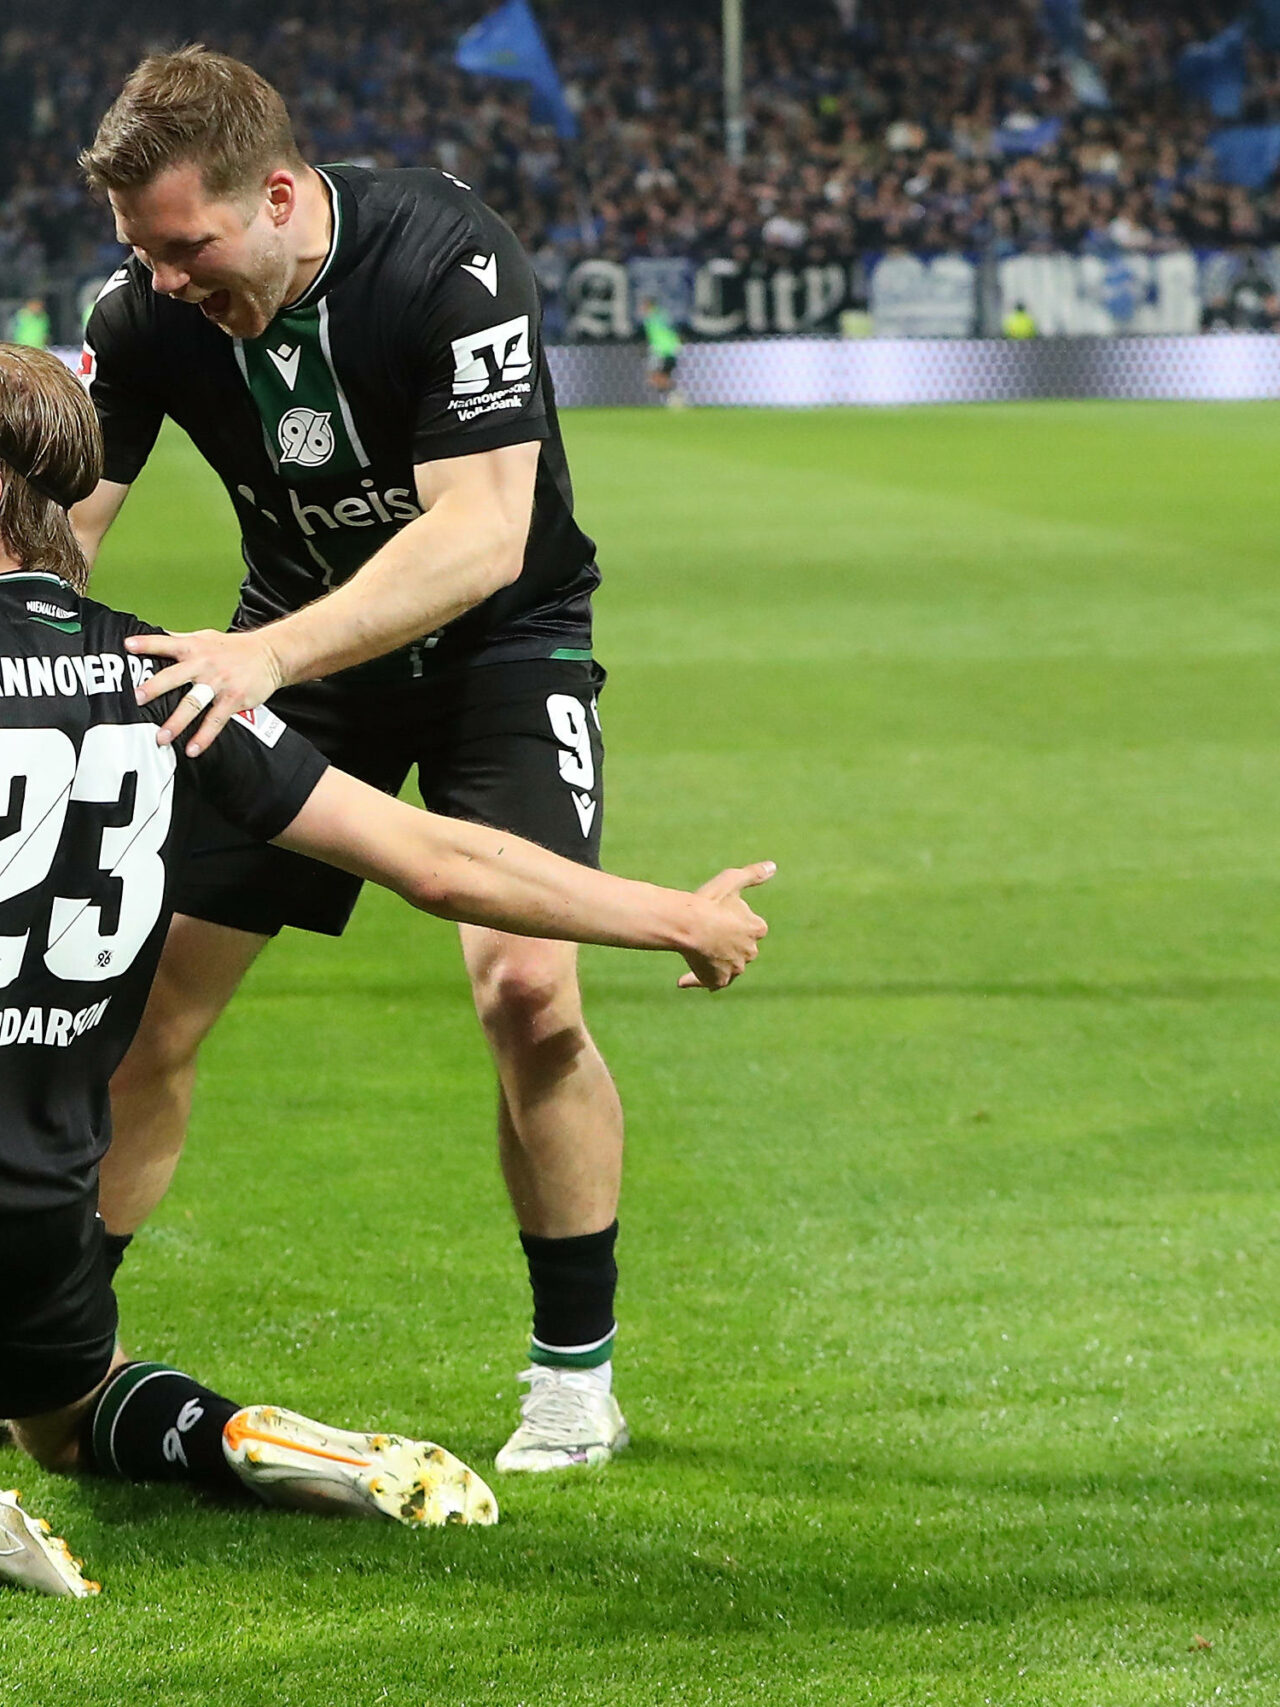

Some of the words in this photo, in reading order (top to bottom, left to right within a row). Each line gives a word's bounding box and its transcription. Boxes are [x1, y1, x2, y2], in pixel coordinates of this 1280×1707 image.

[280, 411, 334, 464] 96
[289, 479, 421, 535] heis
[96, 950, 112, 968] 96
[163, 1397, 205, 1468] 96
